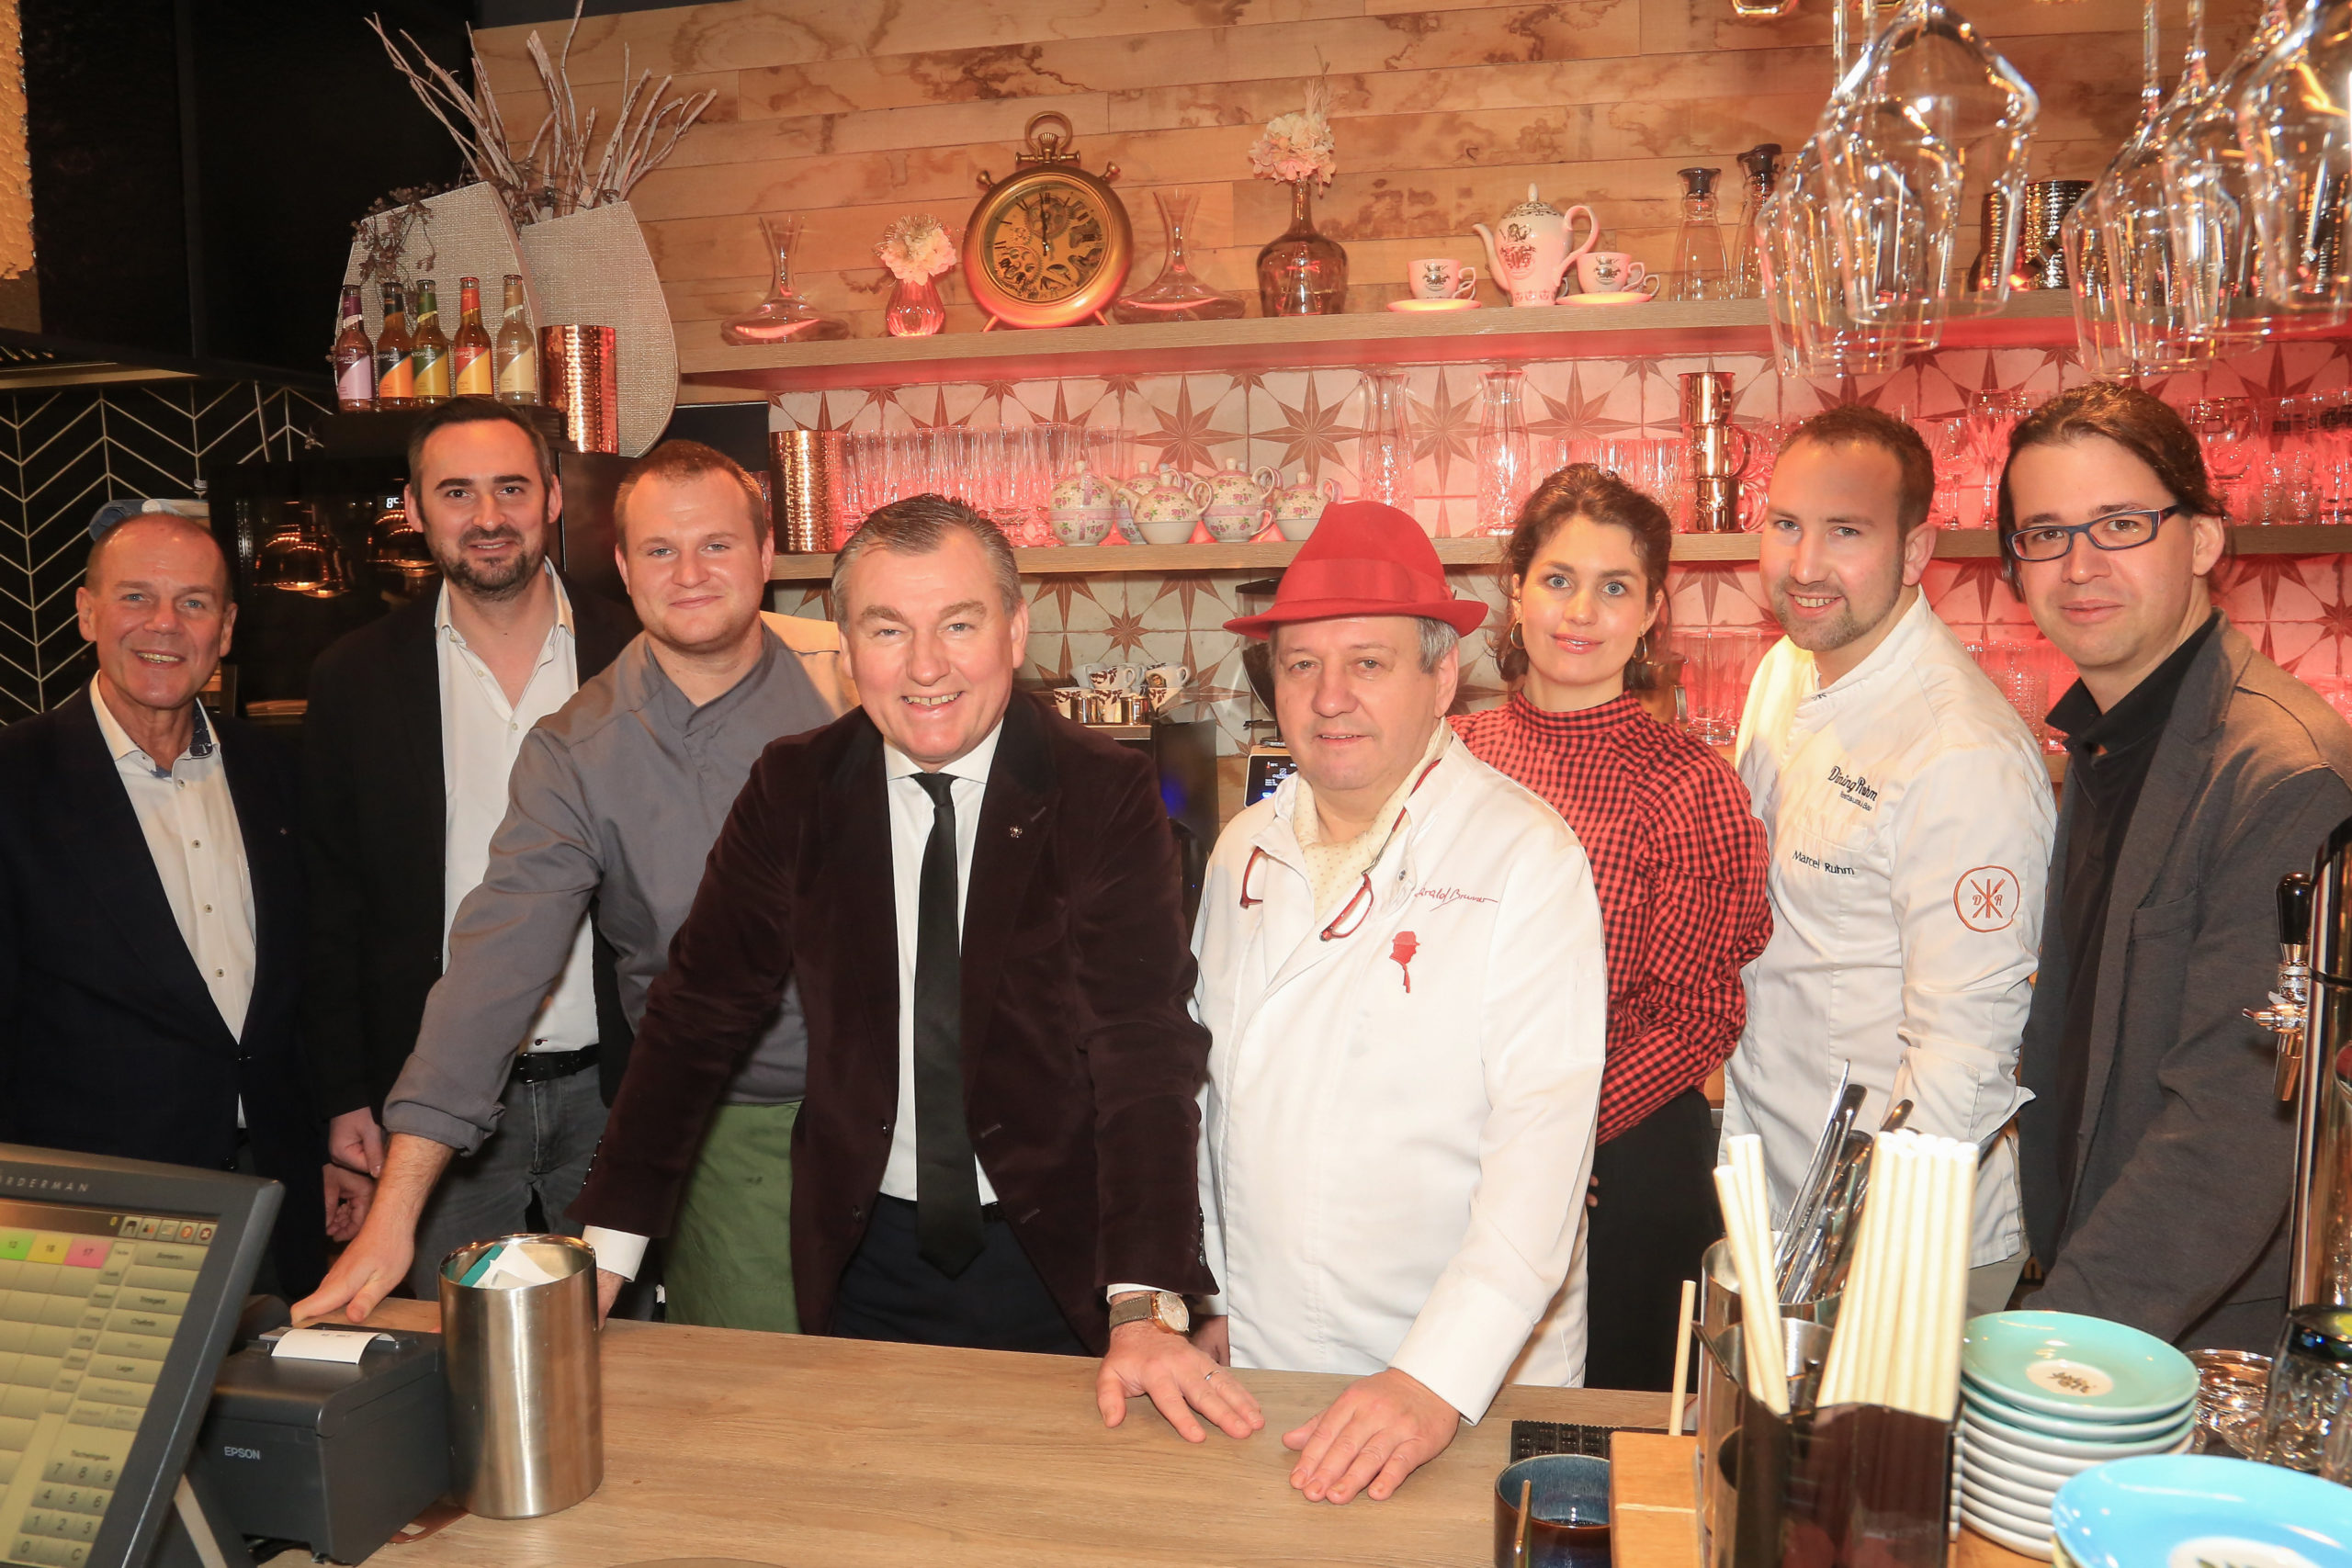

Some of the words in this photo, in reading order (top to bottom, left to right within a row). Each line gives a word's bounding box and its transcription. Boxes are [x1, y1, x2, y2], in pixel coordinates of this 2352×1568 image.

[1792, 850, 1820, 870] Marcel
[1824, 862, 1855, 875] Ruhm
[223, 1446, 261, 1461] EPSON
[54, 1462, 63, 1475] 7
[78, 1466, 88, 1479] 8
[103, 1469, 114, 1483] 9
[42, 1489, 51, 1500] 4
[67, 1491, 78, 1505] 5
[93, 1495, 103, 1508] 6
[56, 1517, 67, 1531] 2
[83, 1521, 93, 1535] 3
[20, 1540, 30, 1554] 0
[71, 1547, 83, 1562] C
